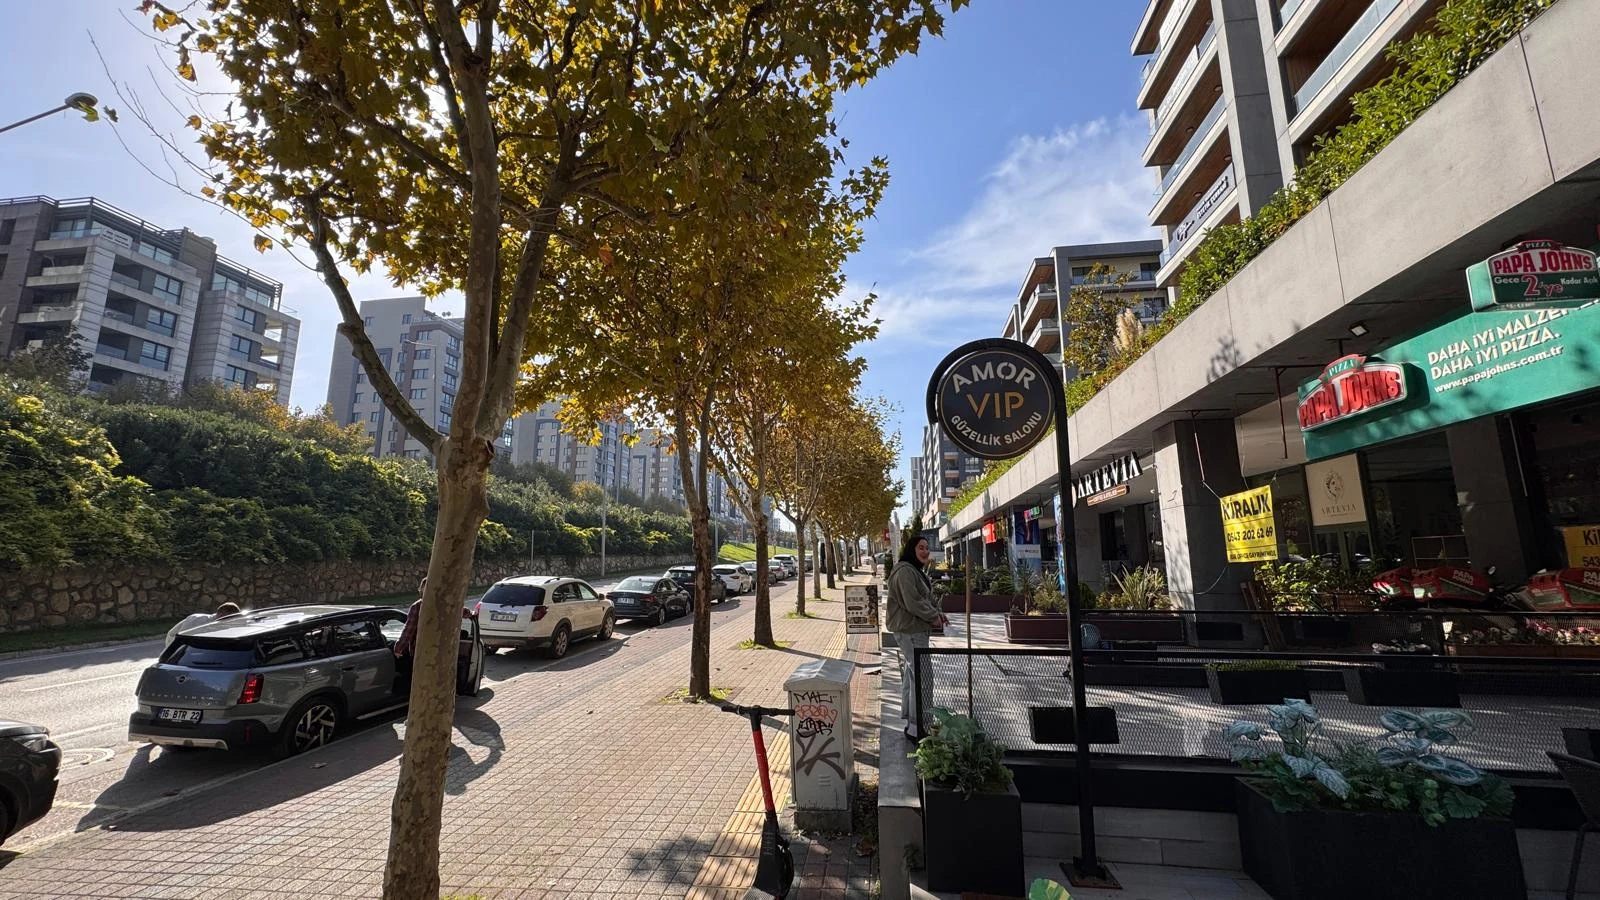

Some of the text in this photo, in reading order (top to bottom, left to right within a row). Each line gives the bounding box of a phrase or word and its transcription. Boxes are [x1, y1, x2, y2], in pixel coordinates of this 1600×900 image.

[1493, 251, 1593, 274] PAPA JOHNS
[1494, 276, 1519, 284] Gece
[1428, 339, 1472, 366] DAHA
[952, 361, 1036, 393] AMOR
[1431, 354, 1475, 380] DAHA
[1434, 345, 1564, 393] www.papajohns.com.tr
[966, 391, 1024, 419] VIP
[1299, 370, 1400, 428] PAPA JOHNS
[951, 411, 1042, 446] GÜZELLİK SALONU
[1078, 451, 1141, 499] ARTEVIA
[1223, 493, 1271, 520] KİRALIK
[1242, 529, 1256, 541] 202
[1256, 527, 1265, 539] 62
[1265, 525, 1273, 538] 69
[162, 709, 200, 720] 16 BTR 22
